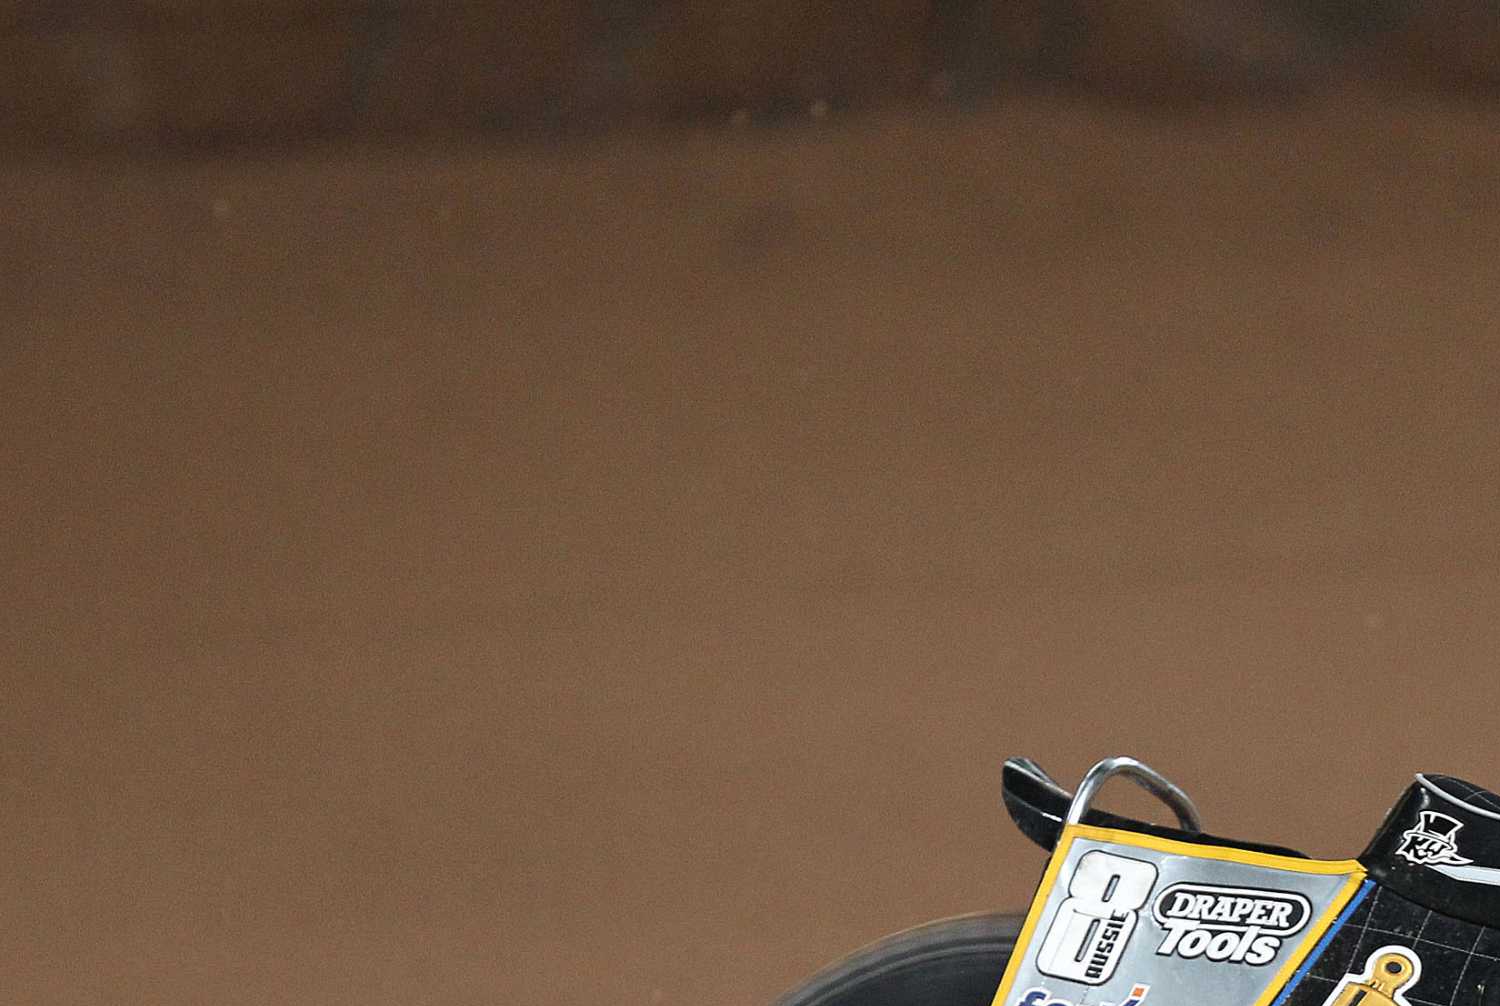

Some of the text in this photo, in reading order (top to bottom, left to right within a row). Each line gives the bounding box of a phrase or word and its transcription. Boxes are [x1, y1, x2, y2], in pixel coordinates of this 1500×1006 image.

[1035, 848, 1159, 986] 8
[1085, 909, 1130, 980] AUSSIE
[1168, 888, 1293, 930] DRAPER
